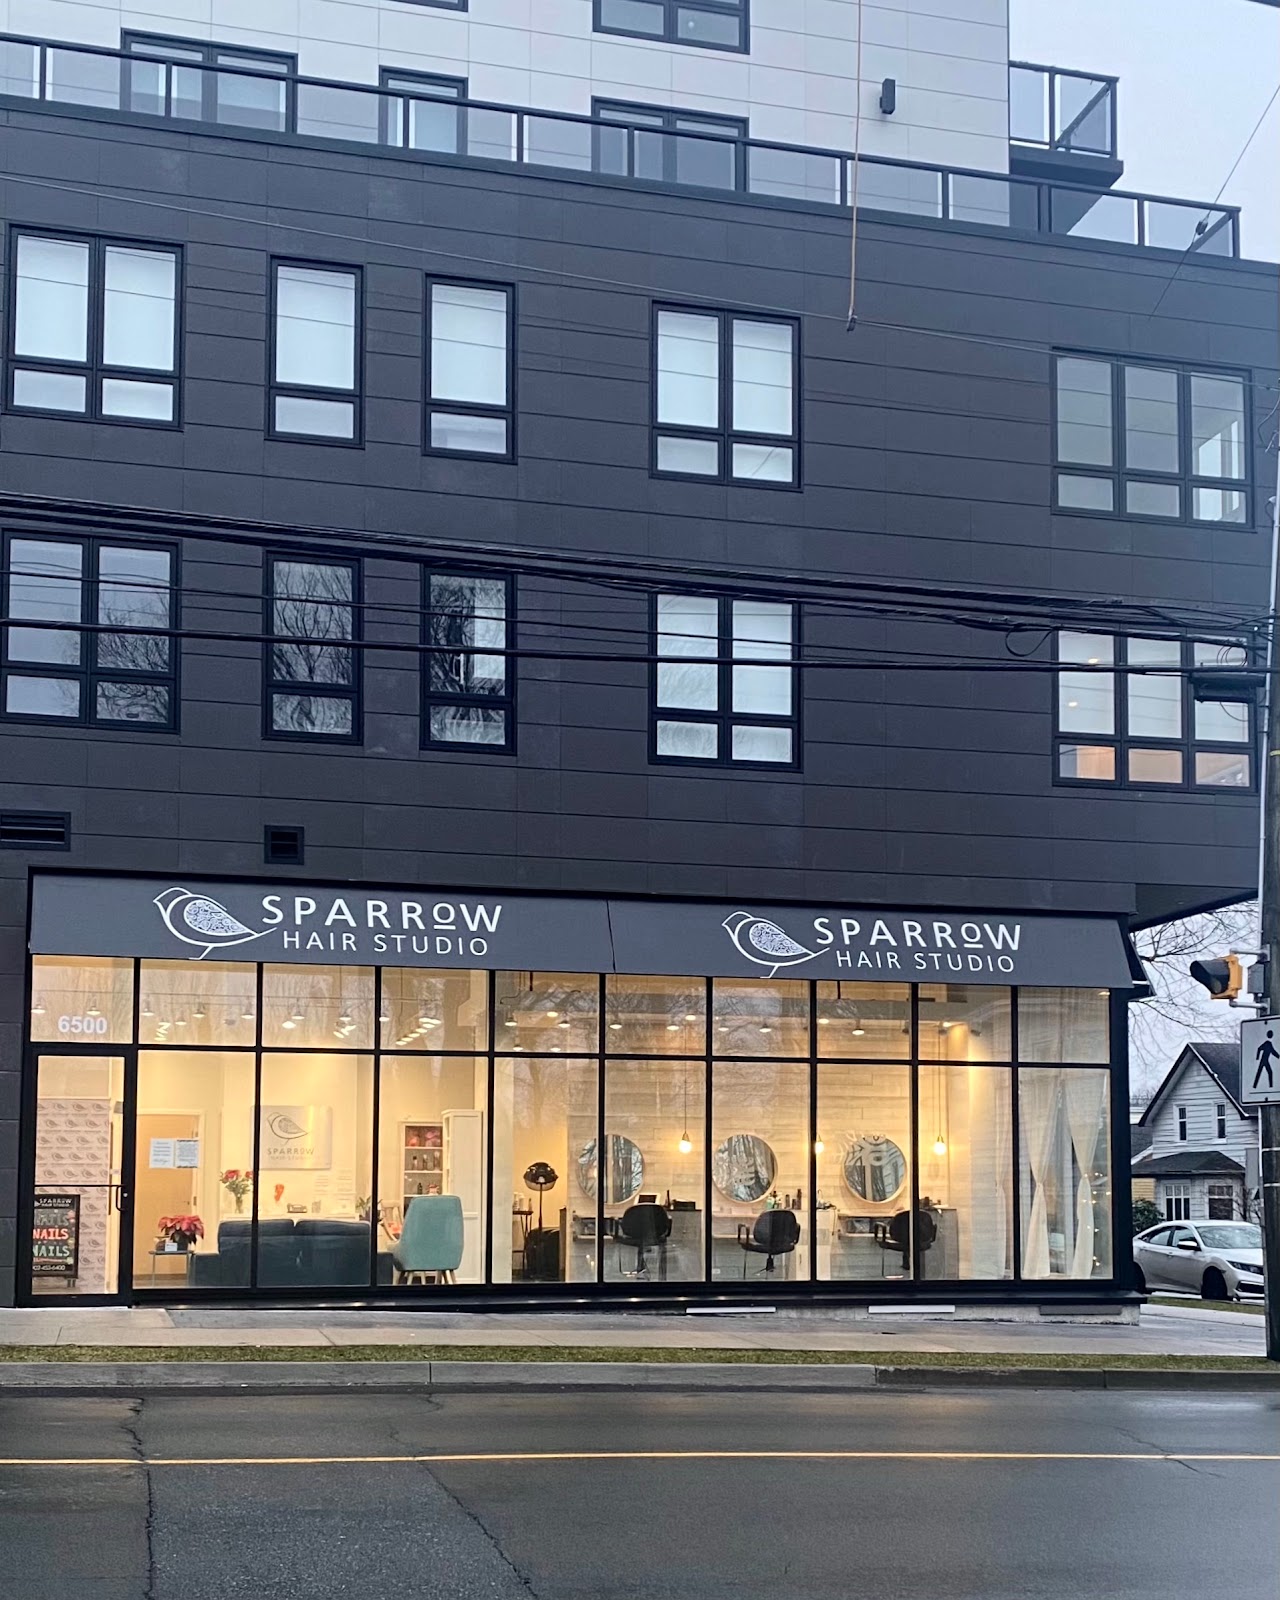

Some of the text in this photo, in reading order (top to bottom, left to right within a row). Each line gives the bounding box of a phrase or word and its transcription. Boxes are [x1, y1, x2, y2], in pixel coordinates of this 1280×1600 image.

[262, 895, 502, 933] SPARROW
[283, 930, 488, 956] HAIR STUDIO
[813, 917, 1021, 951] SPARROW
[836, 950, 1015, 973] HAIR STUDIO
[58, 1015, 108, 1035] 6500
[267, 1147, 315, 1156] SPARROW
[33, 1228, 69, 1240] NAILS
